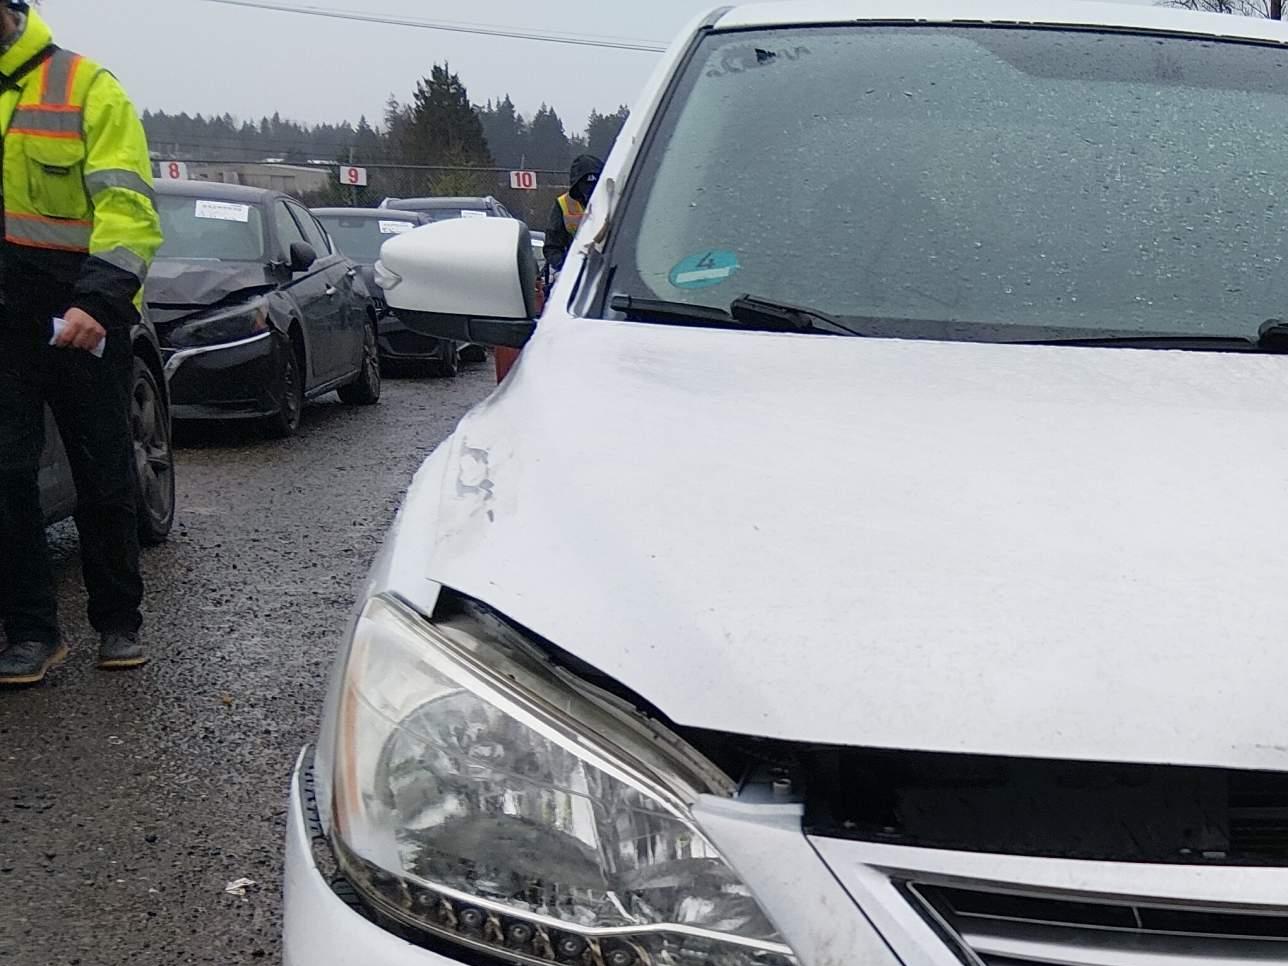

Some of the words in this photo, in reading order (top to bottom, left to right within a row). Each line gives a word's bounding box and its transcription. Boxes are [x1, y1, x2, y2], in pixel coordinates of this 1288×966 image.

[168, 162, 180, 179] 8
[348, 168, 359, 184] 9
[514, 172, 533, 188] 10
[696, 252, 715, 269] 4
